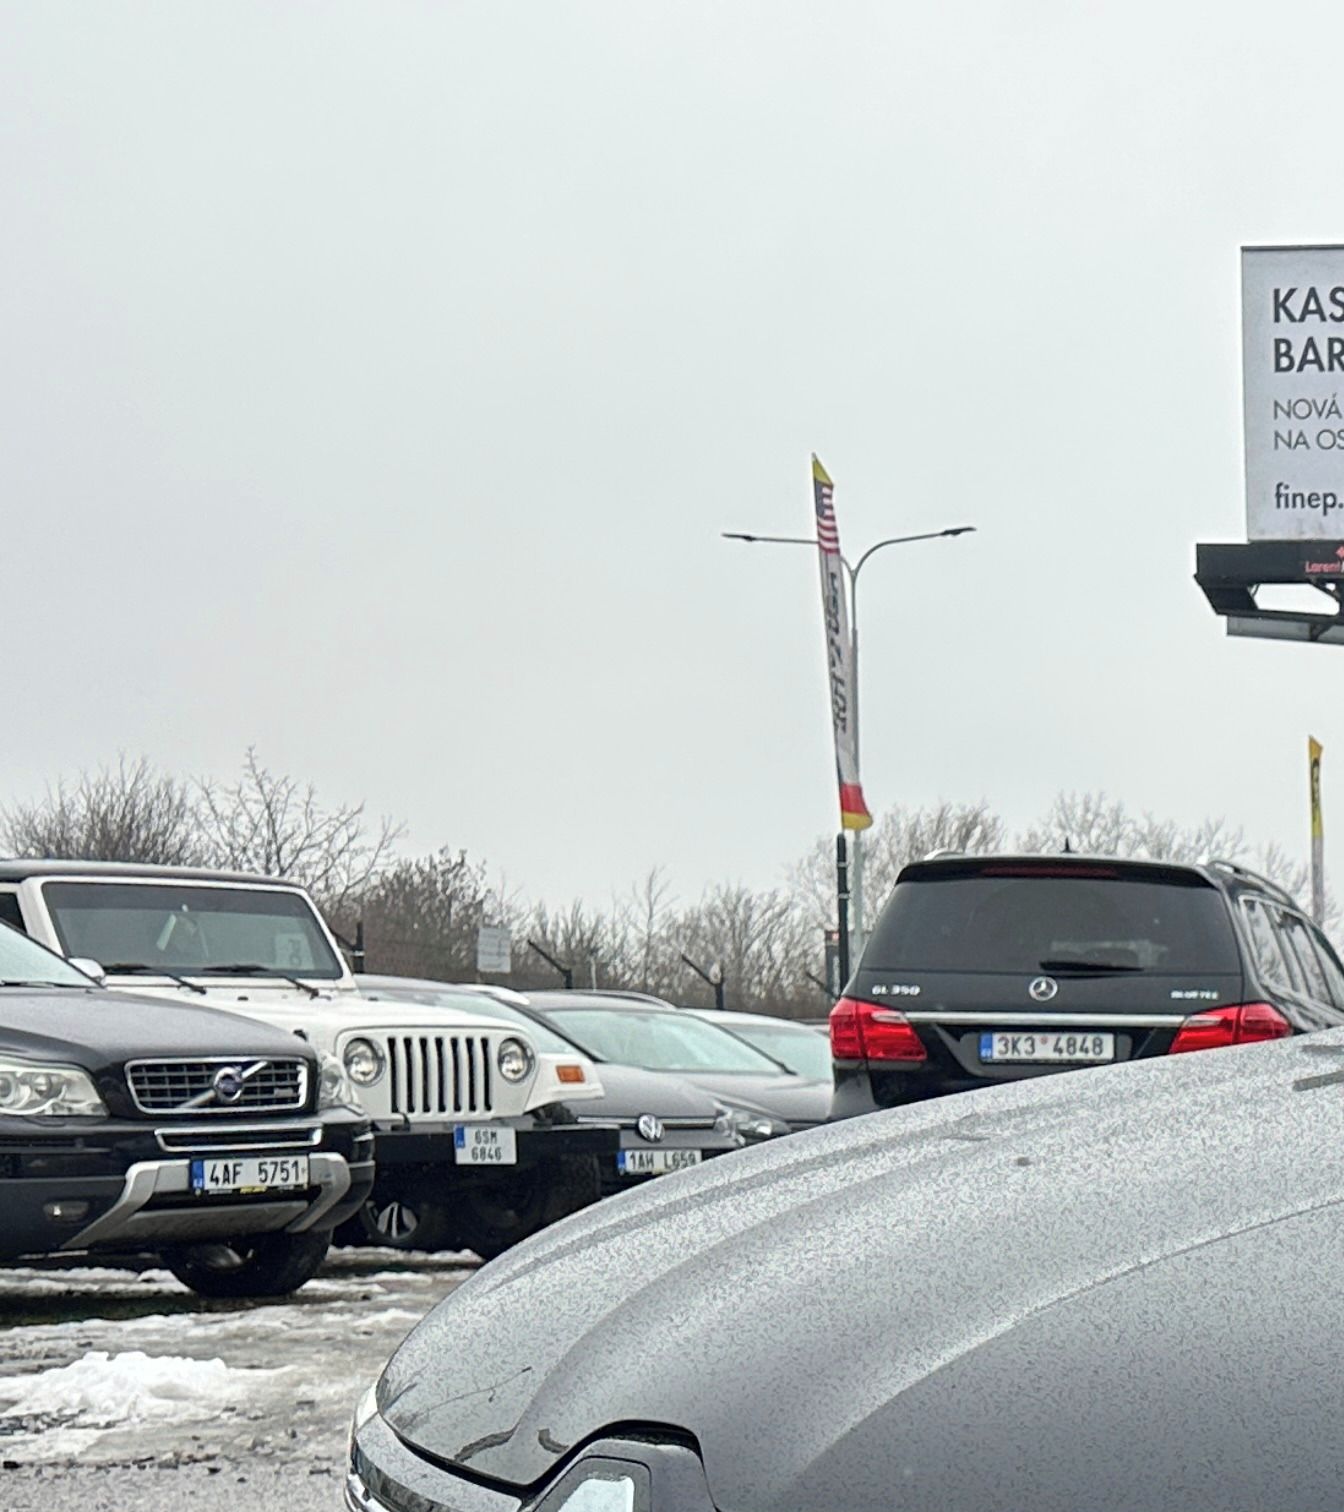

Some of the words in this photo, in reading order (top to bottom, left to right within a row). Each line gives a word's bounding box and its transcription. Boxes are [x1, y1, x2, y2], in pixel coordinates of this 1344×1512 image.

[1273, 392, 1342, 420] NOVÁ
[1273, 429, 1311, 450] NA
[997, 1036, 1036, 1056] 3K3
[1053, 1035, 1104, 1056] 4848
[209, 1162, 243, 1186] 4AF
[258, 1160, 299, 1183] 5751
